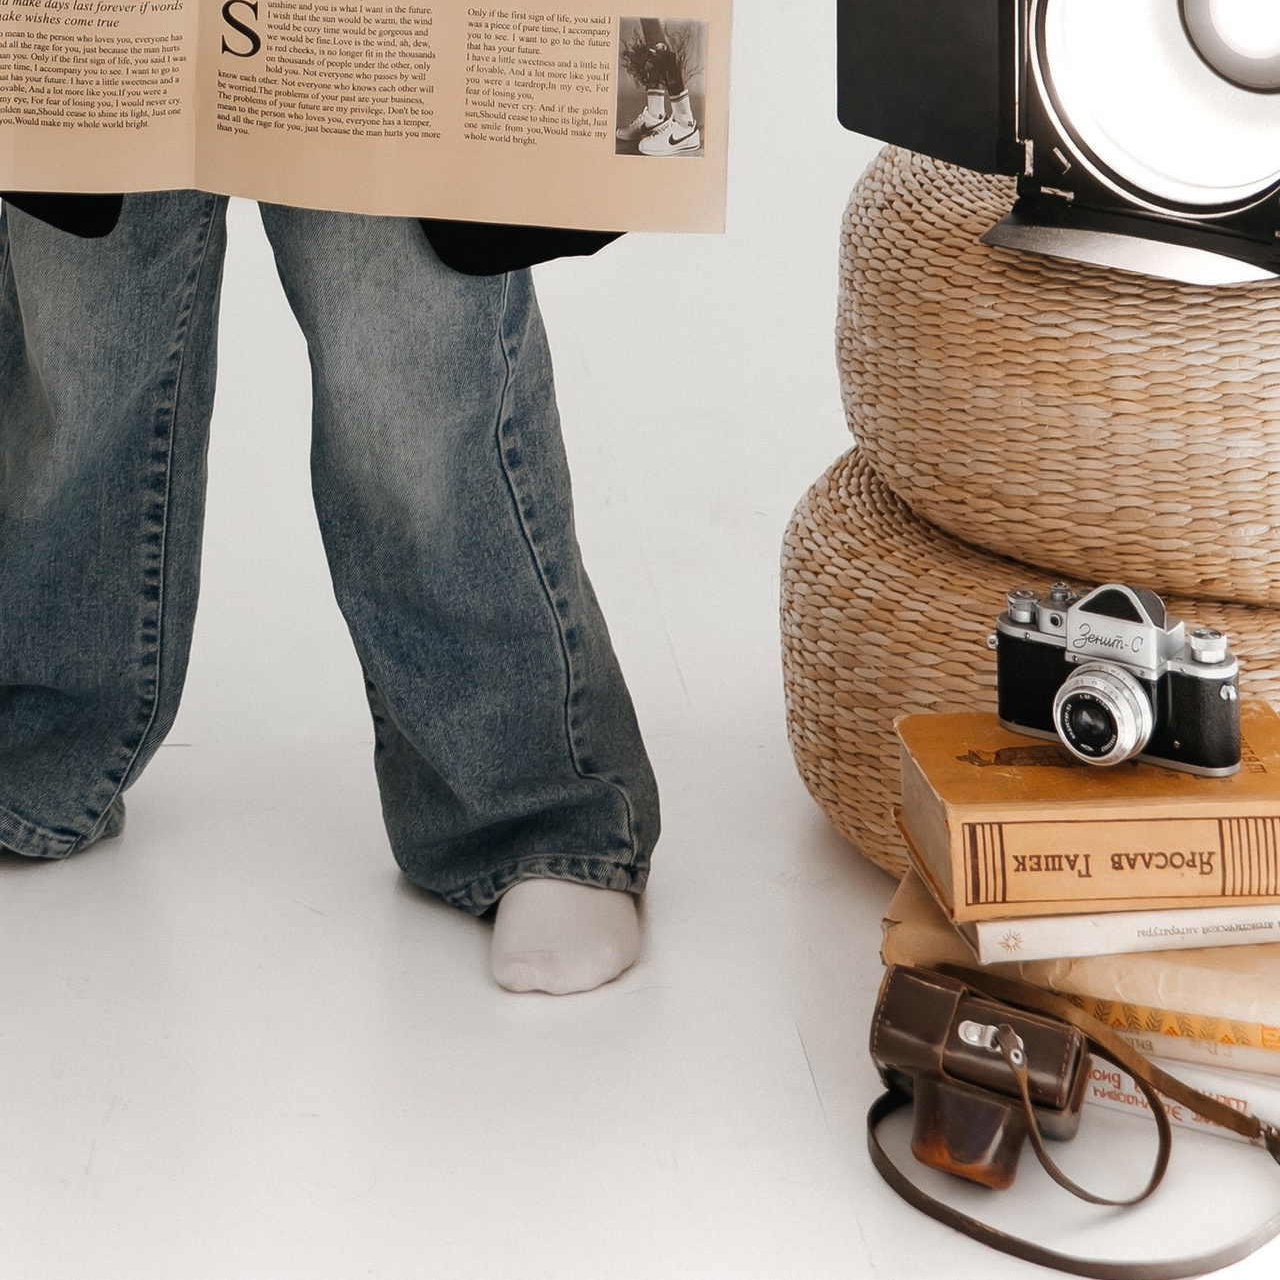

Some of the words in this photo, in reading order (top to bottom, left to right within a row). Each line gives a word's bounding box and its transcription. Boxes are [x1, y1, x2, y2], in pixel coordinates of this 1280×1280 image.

[73, 0, 93, 11] last
[94, 1, 137, 14] forever
[139, 1, 150, 15] if
[151, 0, 183, 11] words
[25, 12, 61, 25] wishes
[64, 18, 94, 27] come
[97, 19, 120, 28] true
[1012, 854, 1093, 878] ГАШЕК
[1111, 851, 1216, 875] ЯРОСЛАВ
